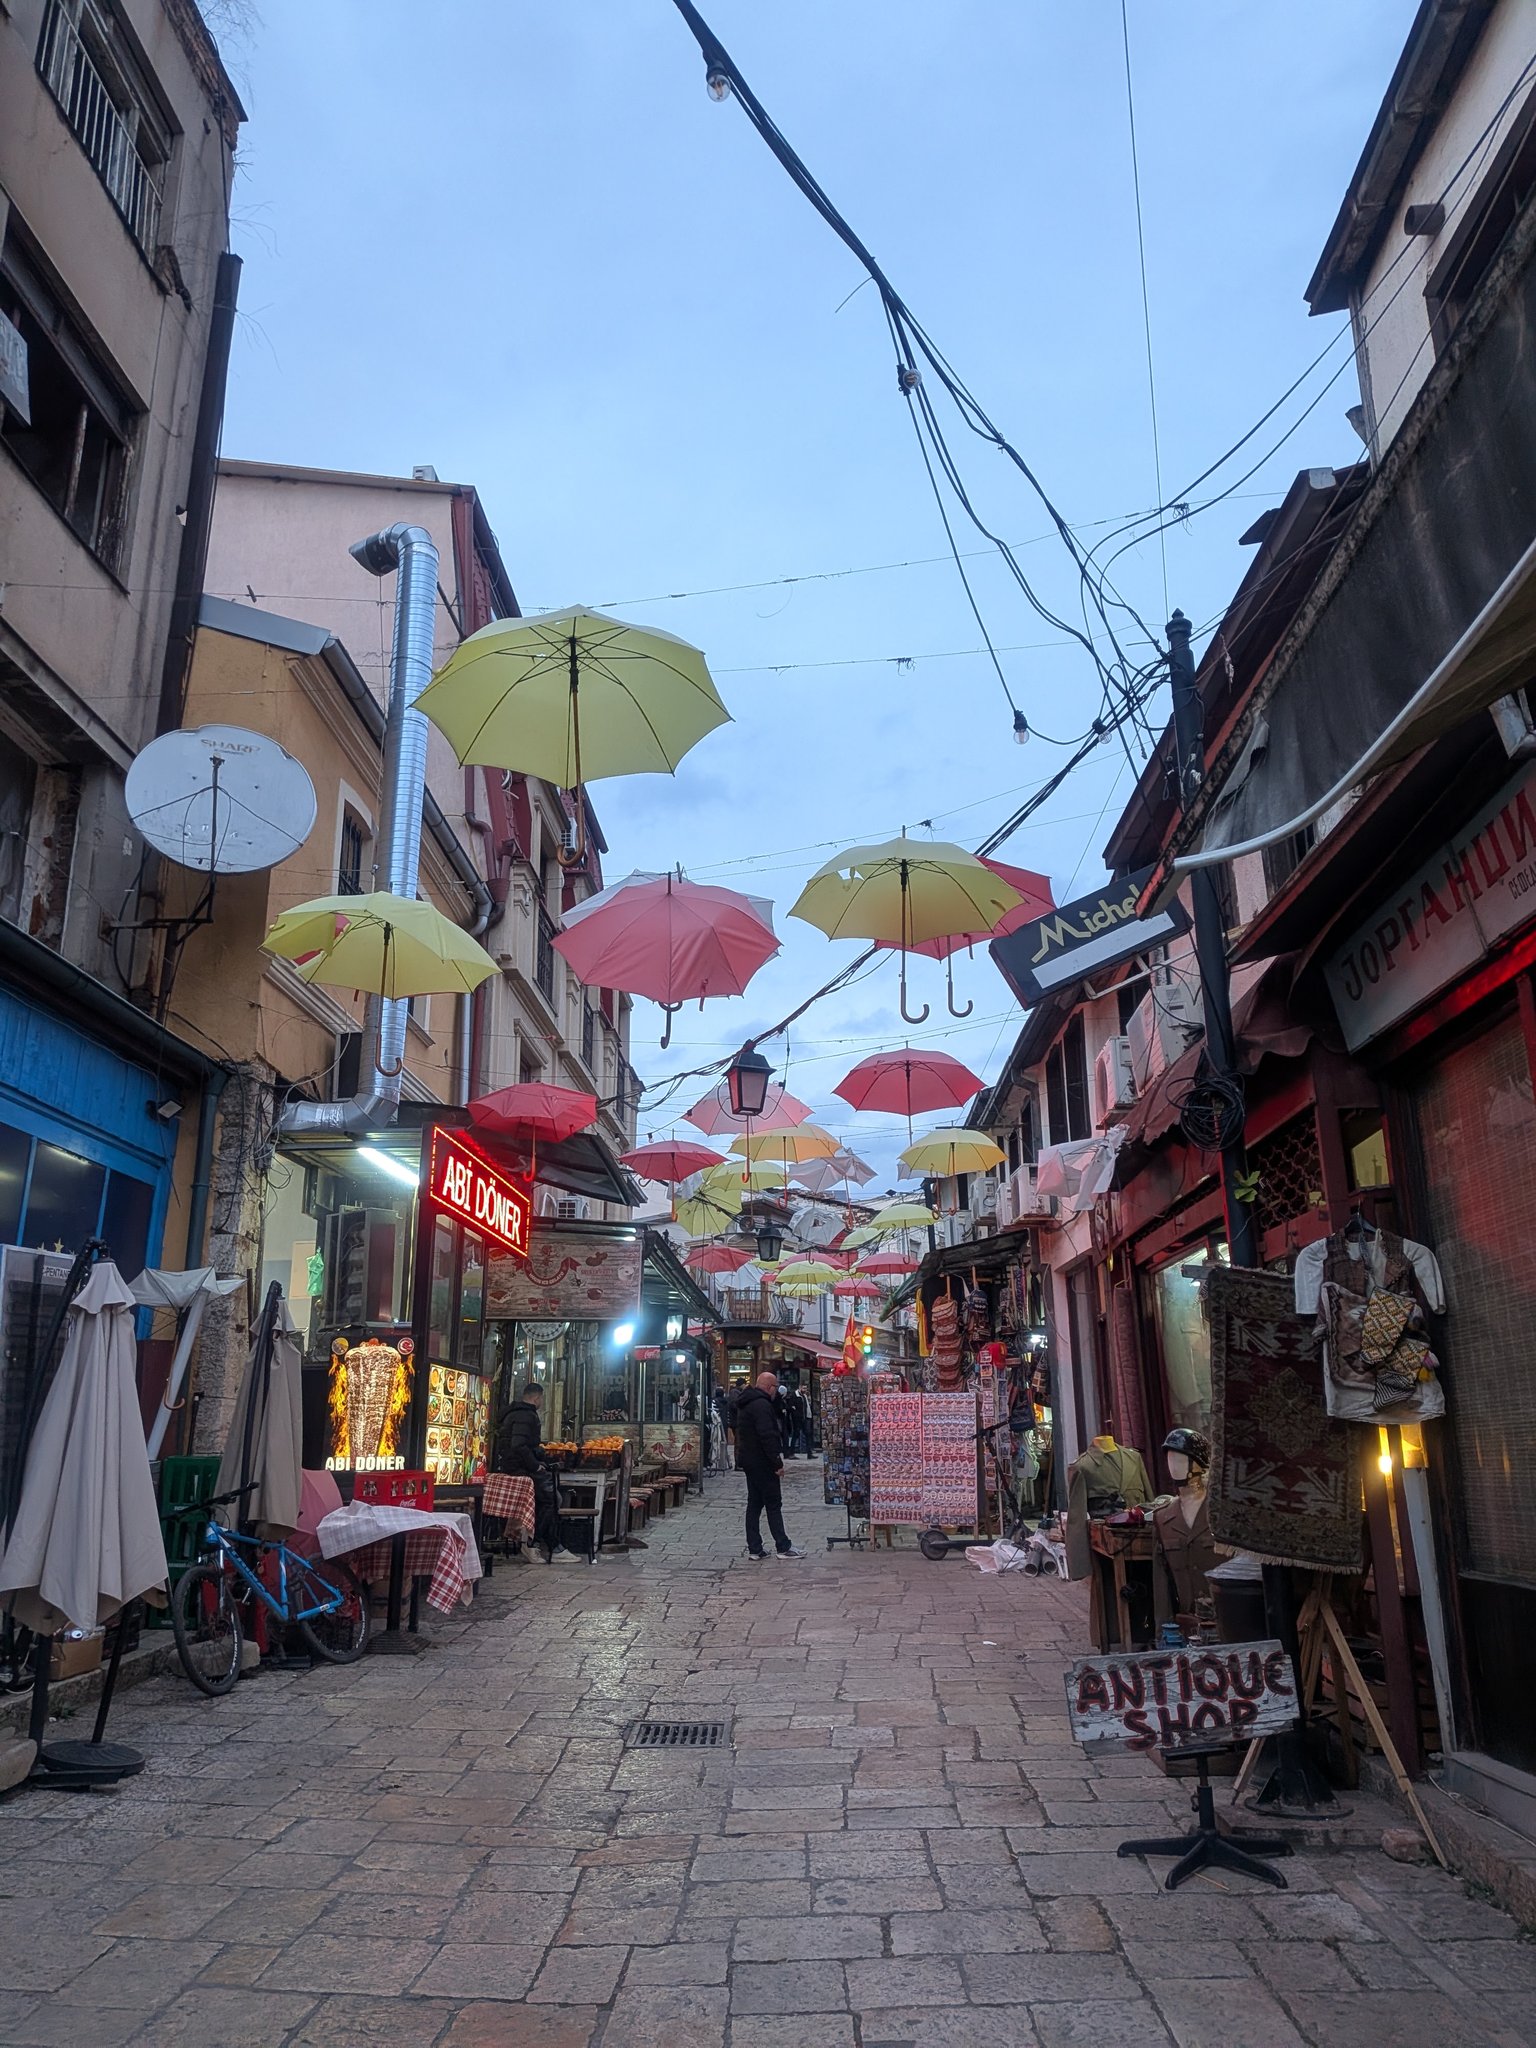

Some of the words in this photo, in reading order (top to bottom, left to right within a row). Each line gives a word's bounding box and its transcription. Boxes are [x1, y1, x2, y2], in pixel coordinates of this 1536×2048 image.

[201, 739, 260, 753] SHARP
[442, 1155, 473, 1212] ABİ
[475, 1177, 521, 1245] DÖNER
[355, 1454, 405, 1471] DÖNER
[1077, 1650, 1294, 1714] ANTIQUE
[1123, 1698, 1259, 1750] SHOP
